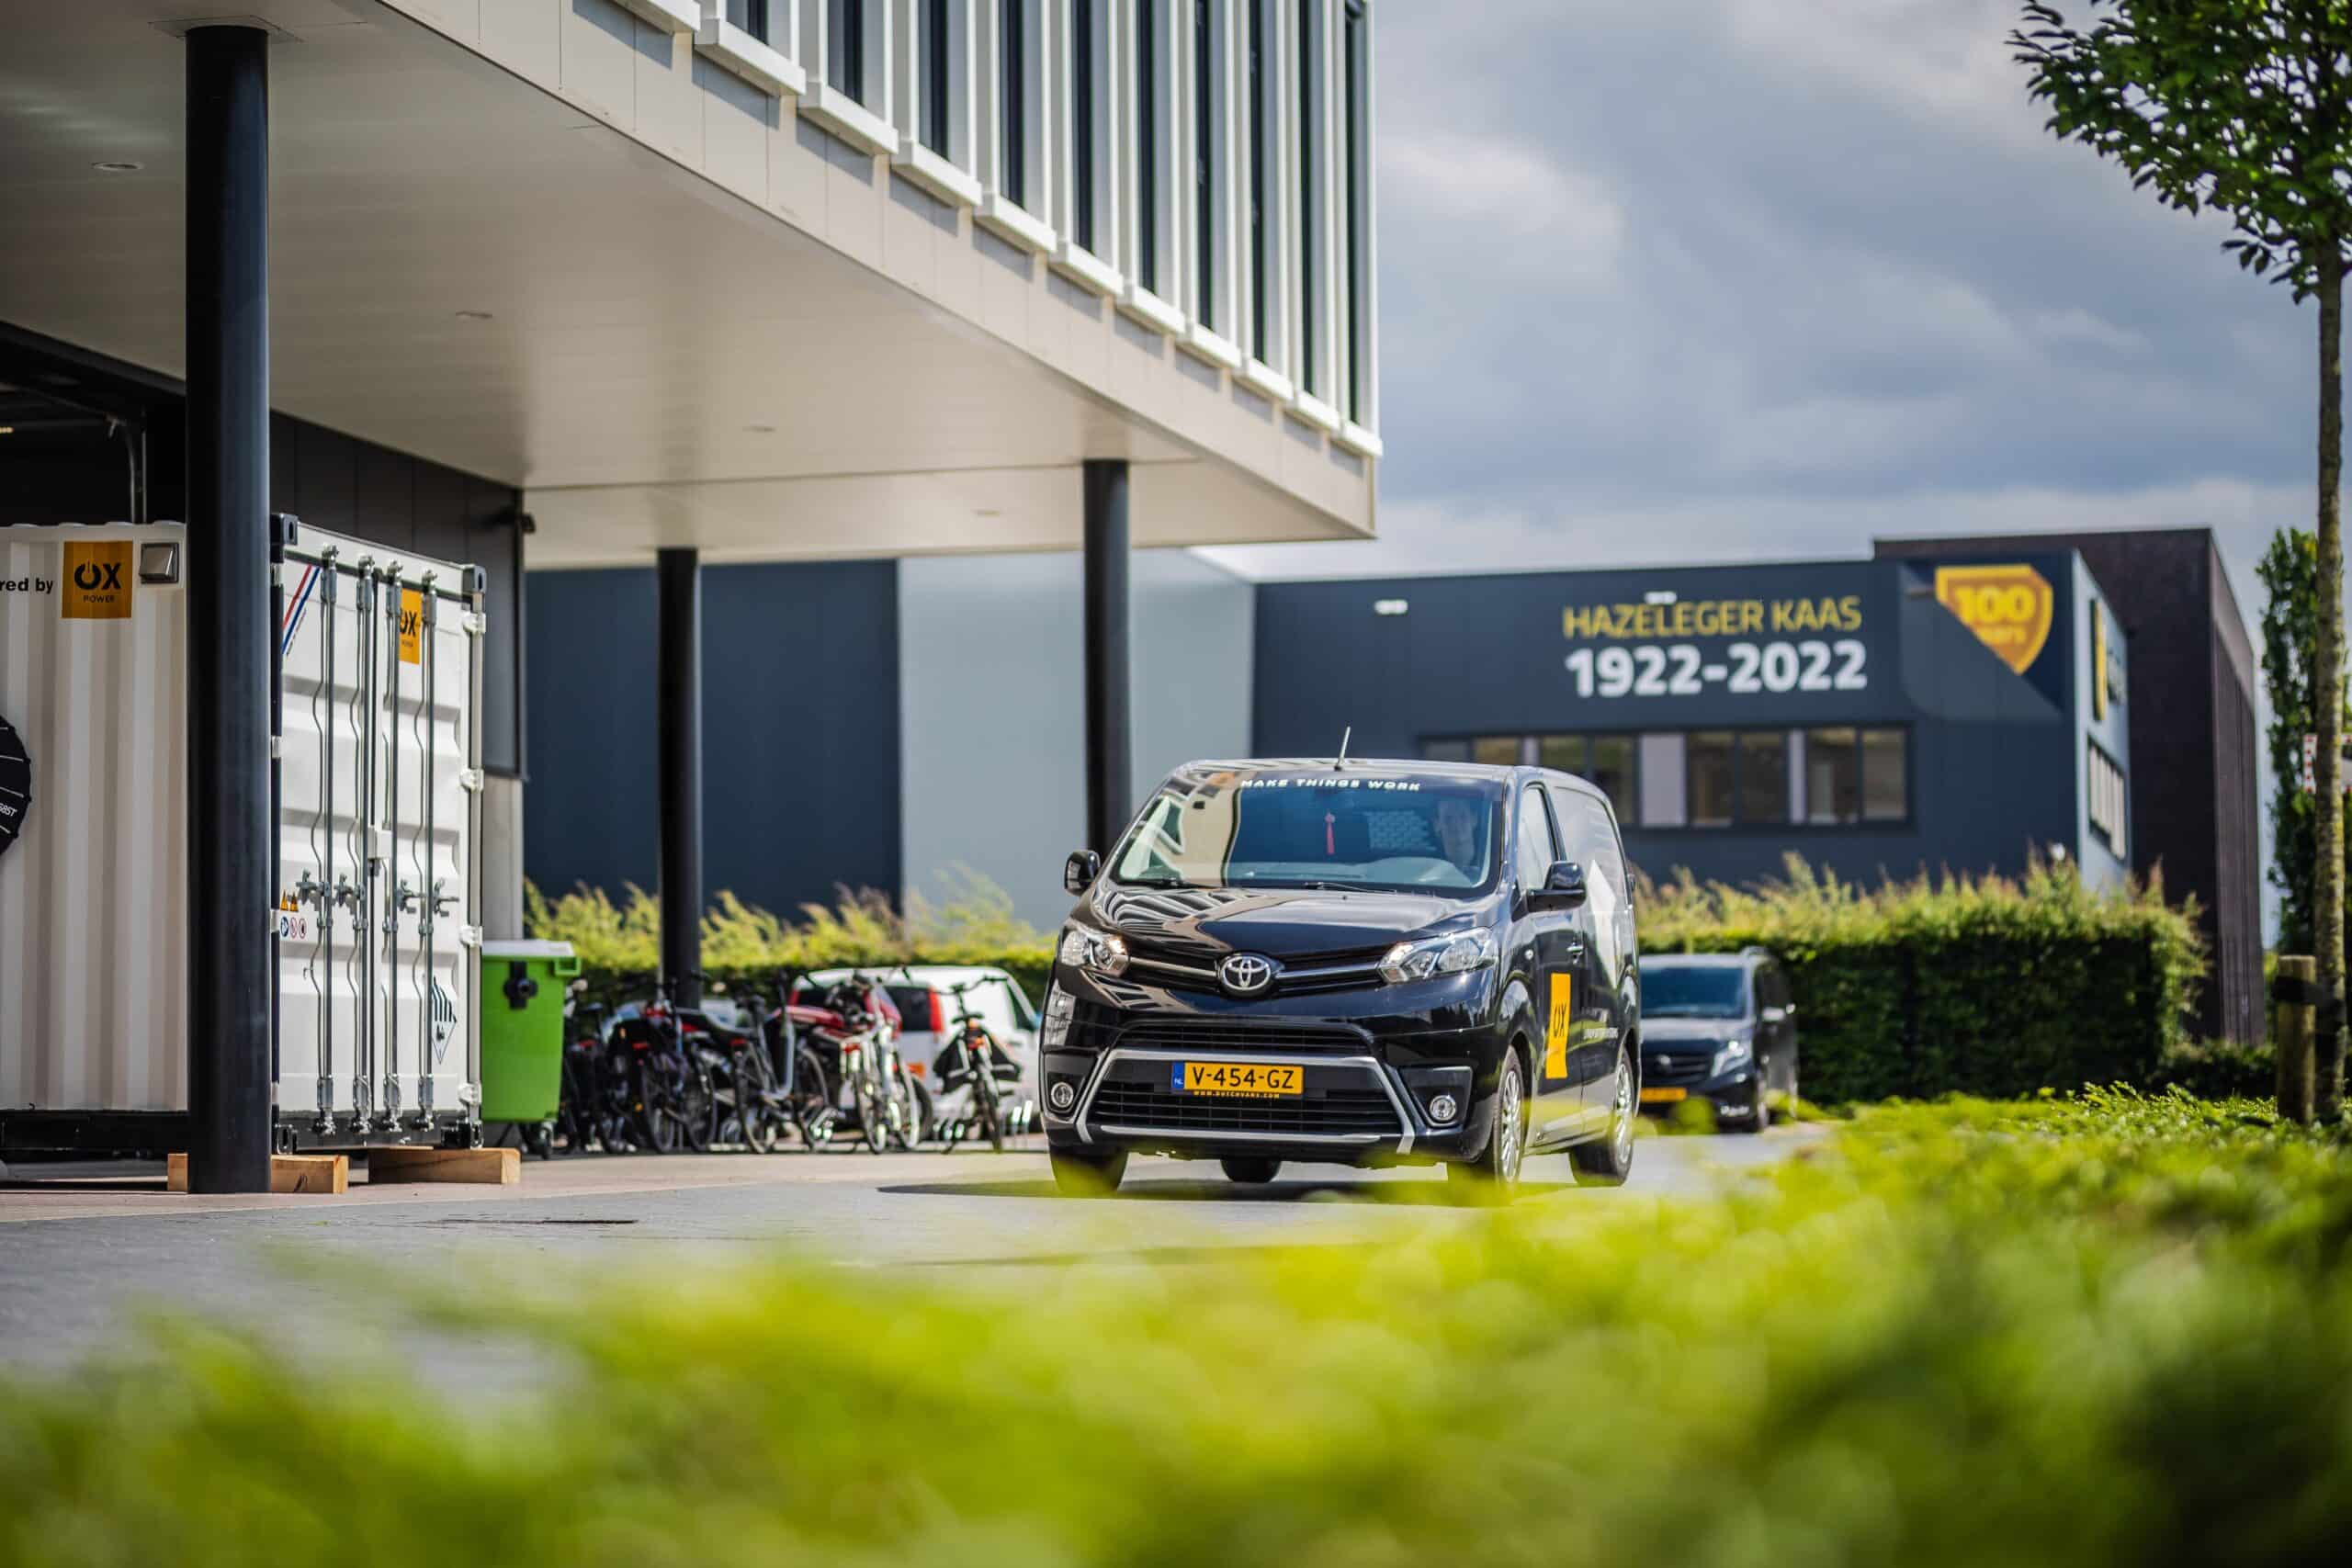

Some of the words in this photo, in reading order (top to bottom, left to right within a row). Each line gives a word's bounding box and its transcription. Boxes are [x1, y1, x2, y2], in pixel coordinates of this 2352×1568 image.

[35, 577, 54, 594] by
[83, 594, 115, 604] POWER
[1954, 584, 2037, 626] 100
[1563, 599, 1765, 638] HAZELEGER
[1770, 595, 1864, 632] KAAS
[1565, 639, 1869, 698] 1922-2022
[1240, 778, 1289, 789] MAKE
[1295, 778, 1361, 789] THINGS
[1367, 780, 1421, 792] WORK
[1193, 1066, 1295, 1090] V-454-GZ
